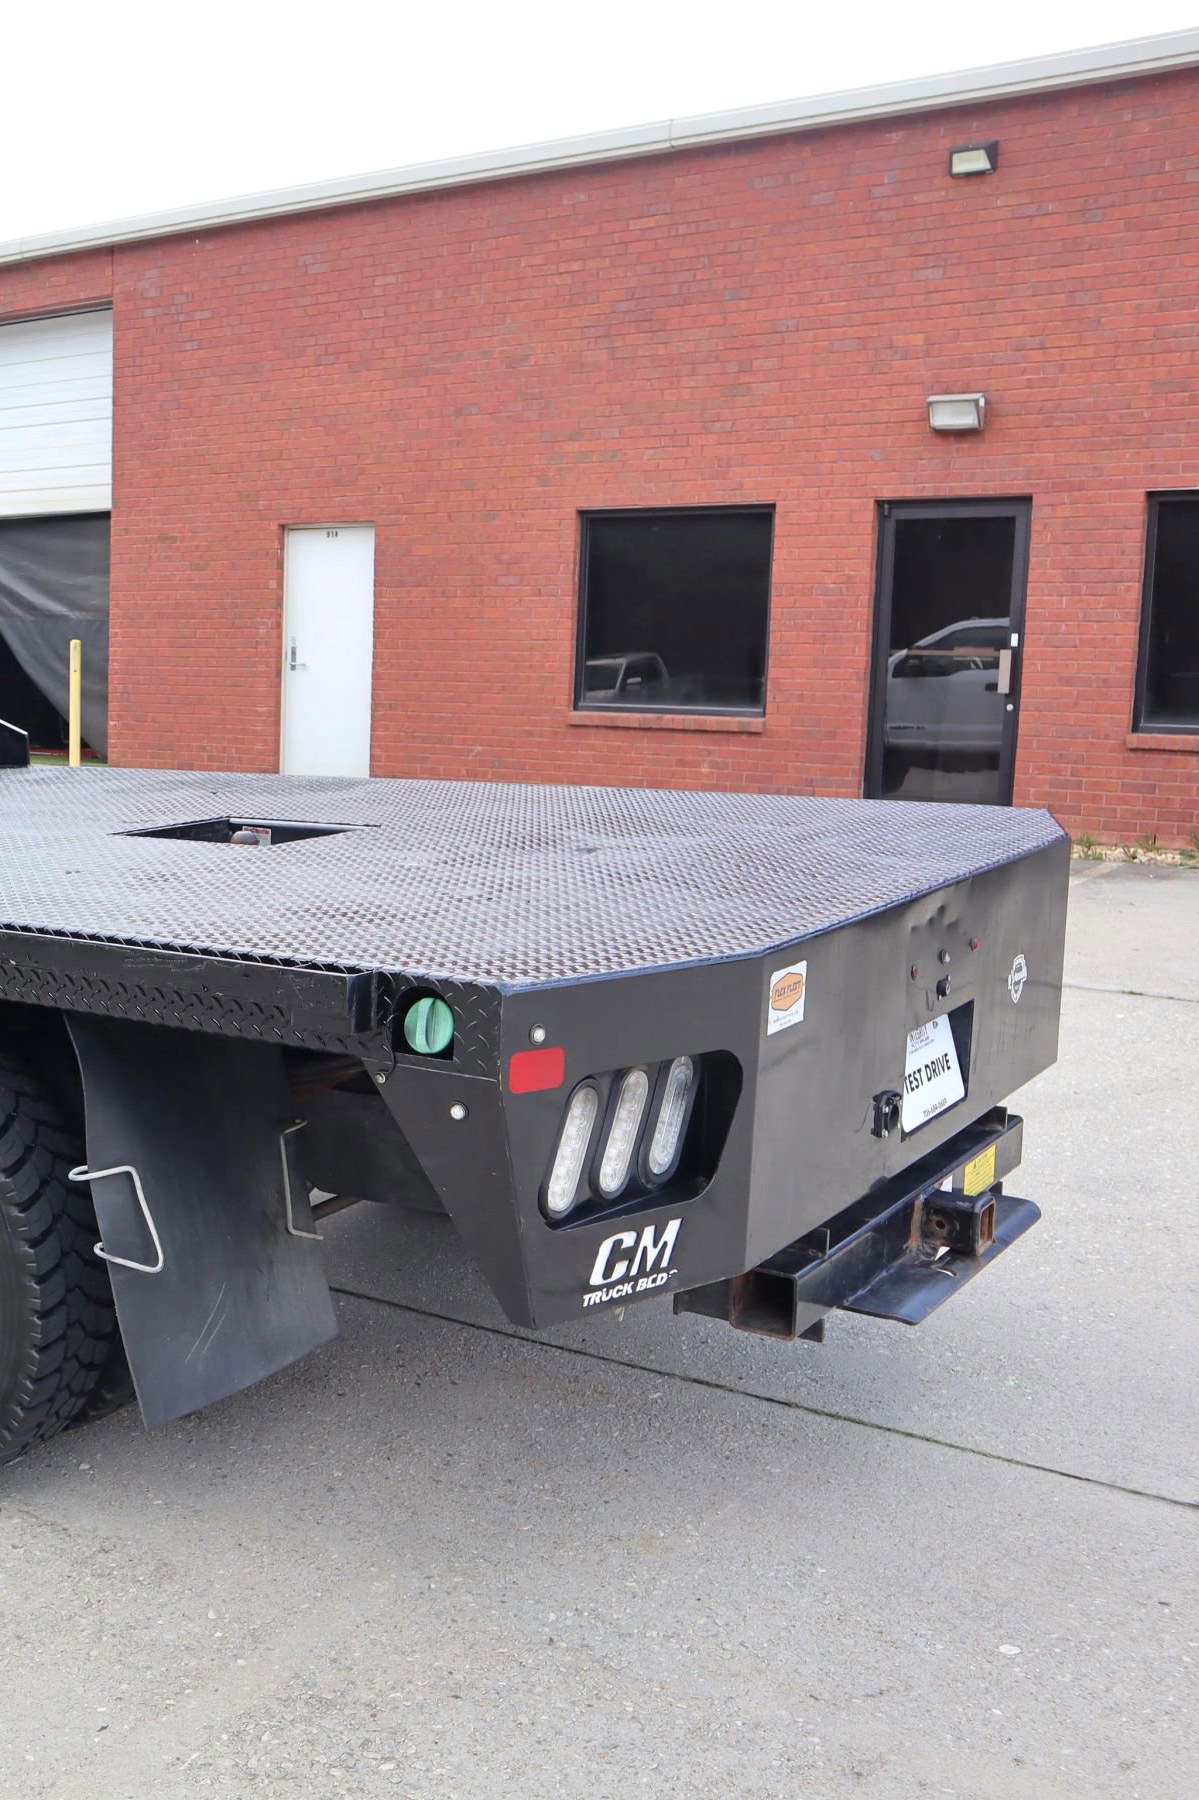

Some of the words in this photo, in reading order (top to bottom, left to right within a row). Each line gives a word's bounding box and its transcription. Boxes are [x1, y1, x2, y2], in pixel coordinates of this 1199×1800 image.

[904, 1066, 924, 1095] TEST
[924, 1052, 951, 1083] DRIVE
[589, 1217, 684, 1286] CM
[582, 1281, 635, 1308] TRUCK
